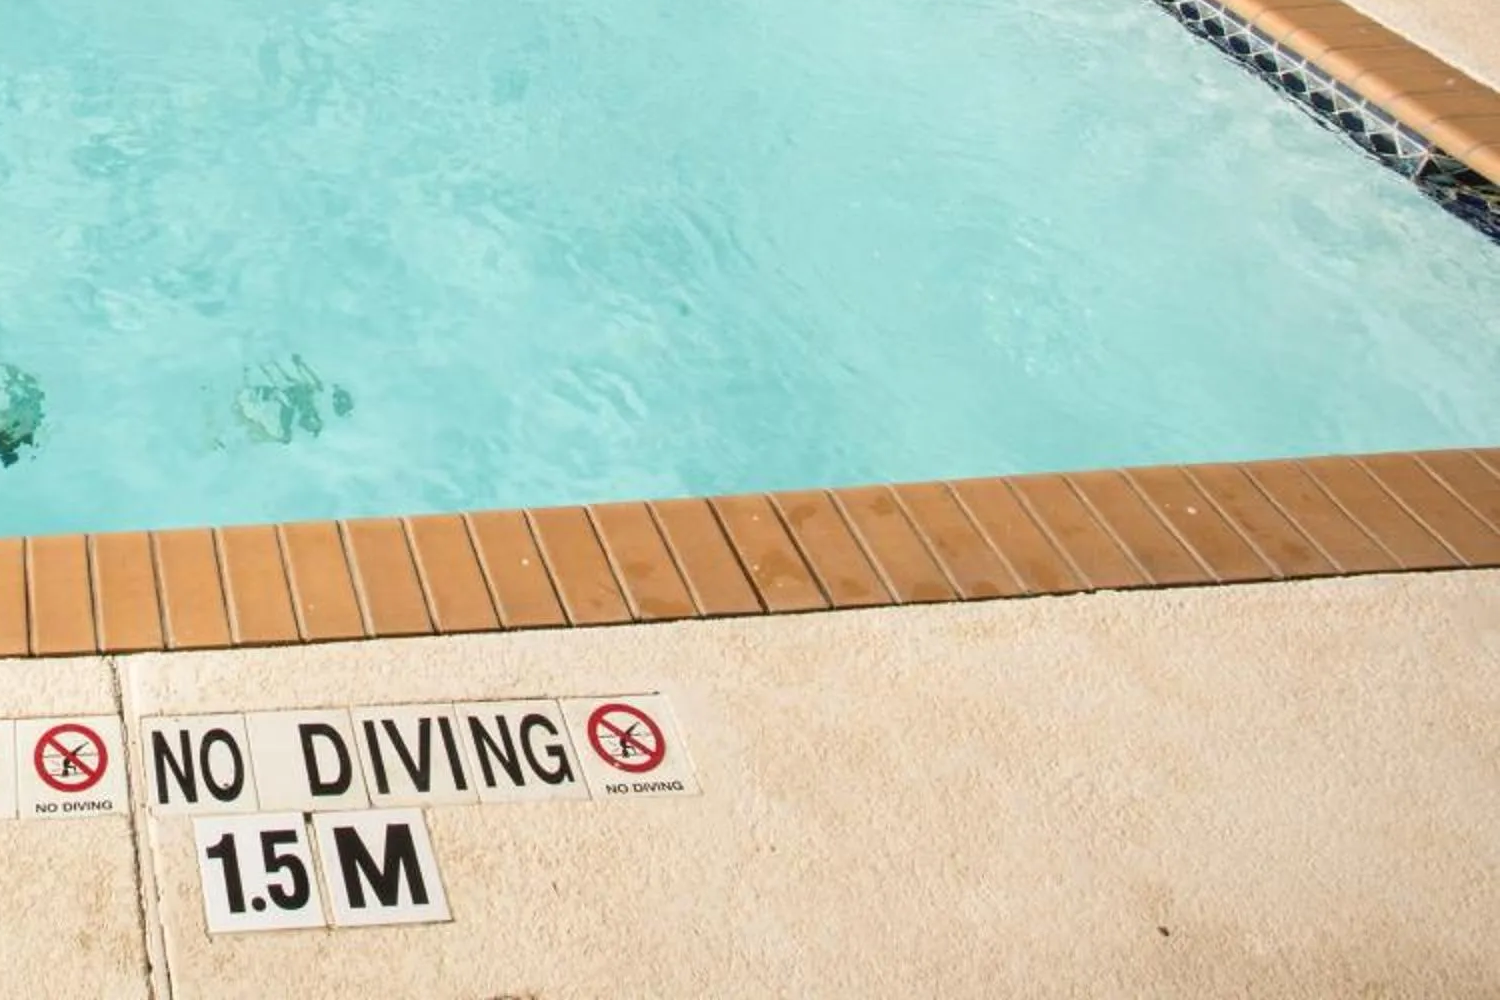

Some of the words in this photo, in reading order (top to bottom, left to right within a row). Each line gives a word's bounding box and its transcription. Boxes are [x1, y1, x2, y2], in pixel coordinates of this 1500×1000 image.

[151, 727, 245, 804] NO
[297, 713, 575, 797] DIVING
[35, 802, 58, 814] NO
[63, 799, 113, 812] DIVING
[605, 783, 629, 796] NO
[632, 780, 684, 793] DIVING
[205, 829, 311, 914] 1.5
[333, 823, 429, 909] M
